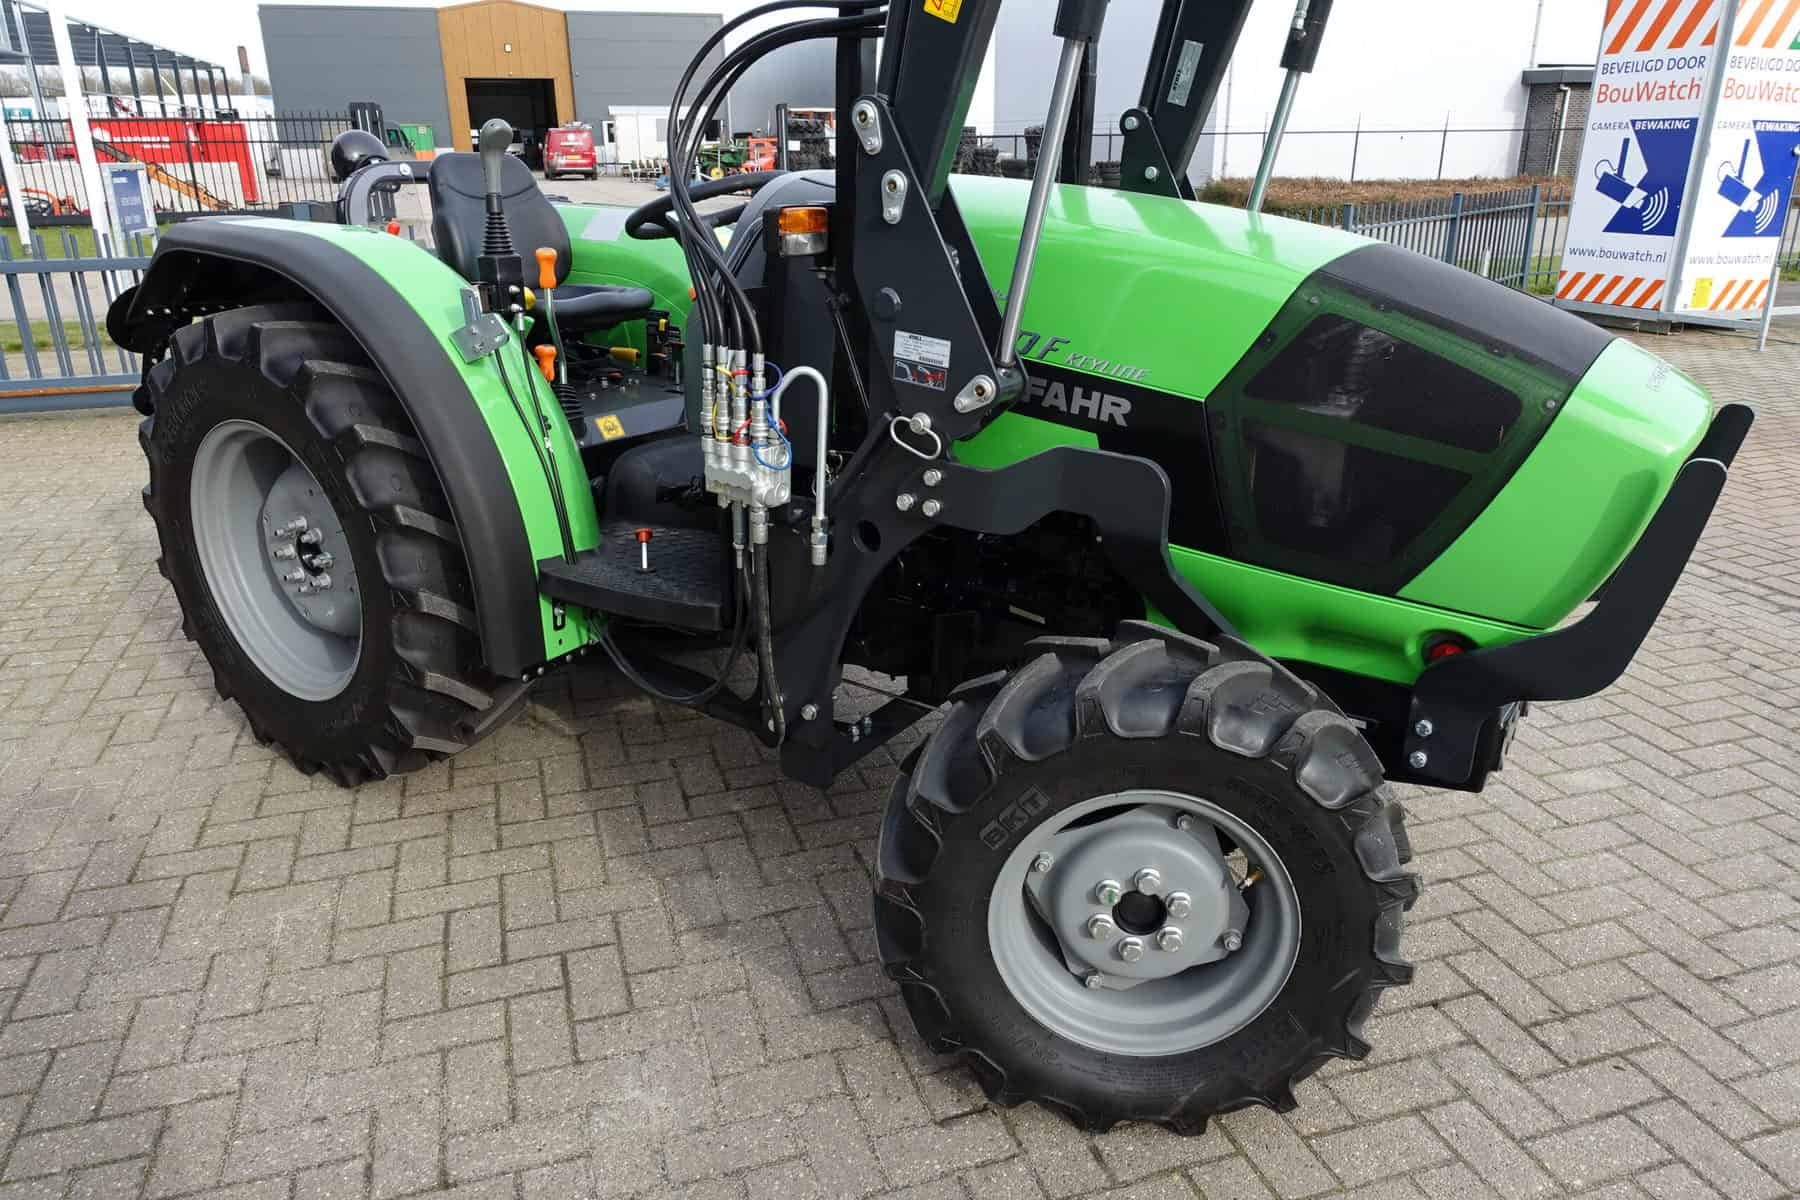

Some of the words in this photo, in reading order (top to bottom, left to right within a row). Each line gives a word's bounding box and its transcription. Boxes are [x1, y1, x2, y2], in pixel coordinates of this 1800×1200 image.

[1601, 59, 1664, 75] BEVEILIGD
[1666, 55, 1706, 71] DOOR
[1730, 55, 1783, 71] BEVEILIGD
[1597, 77, 1702, 104] BouWatch
[1591, 121, 1630, 131] CAMERA
[1634, 119, 1691, 131] BEWAKING
[1568, 246, 1667, 264] www.bouwatch.nl
[1021, 376, 1132, 427] FAHR
